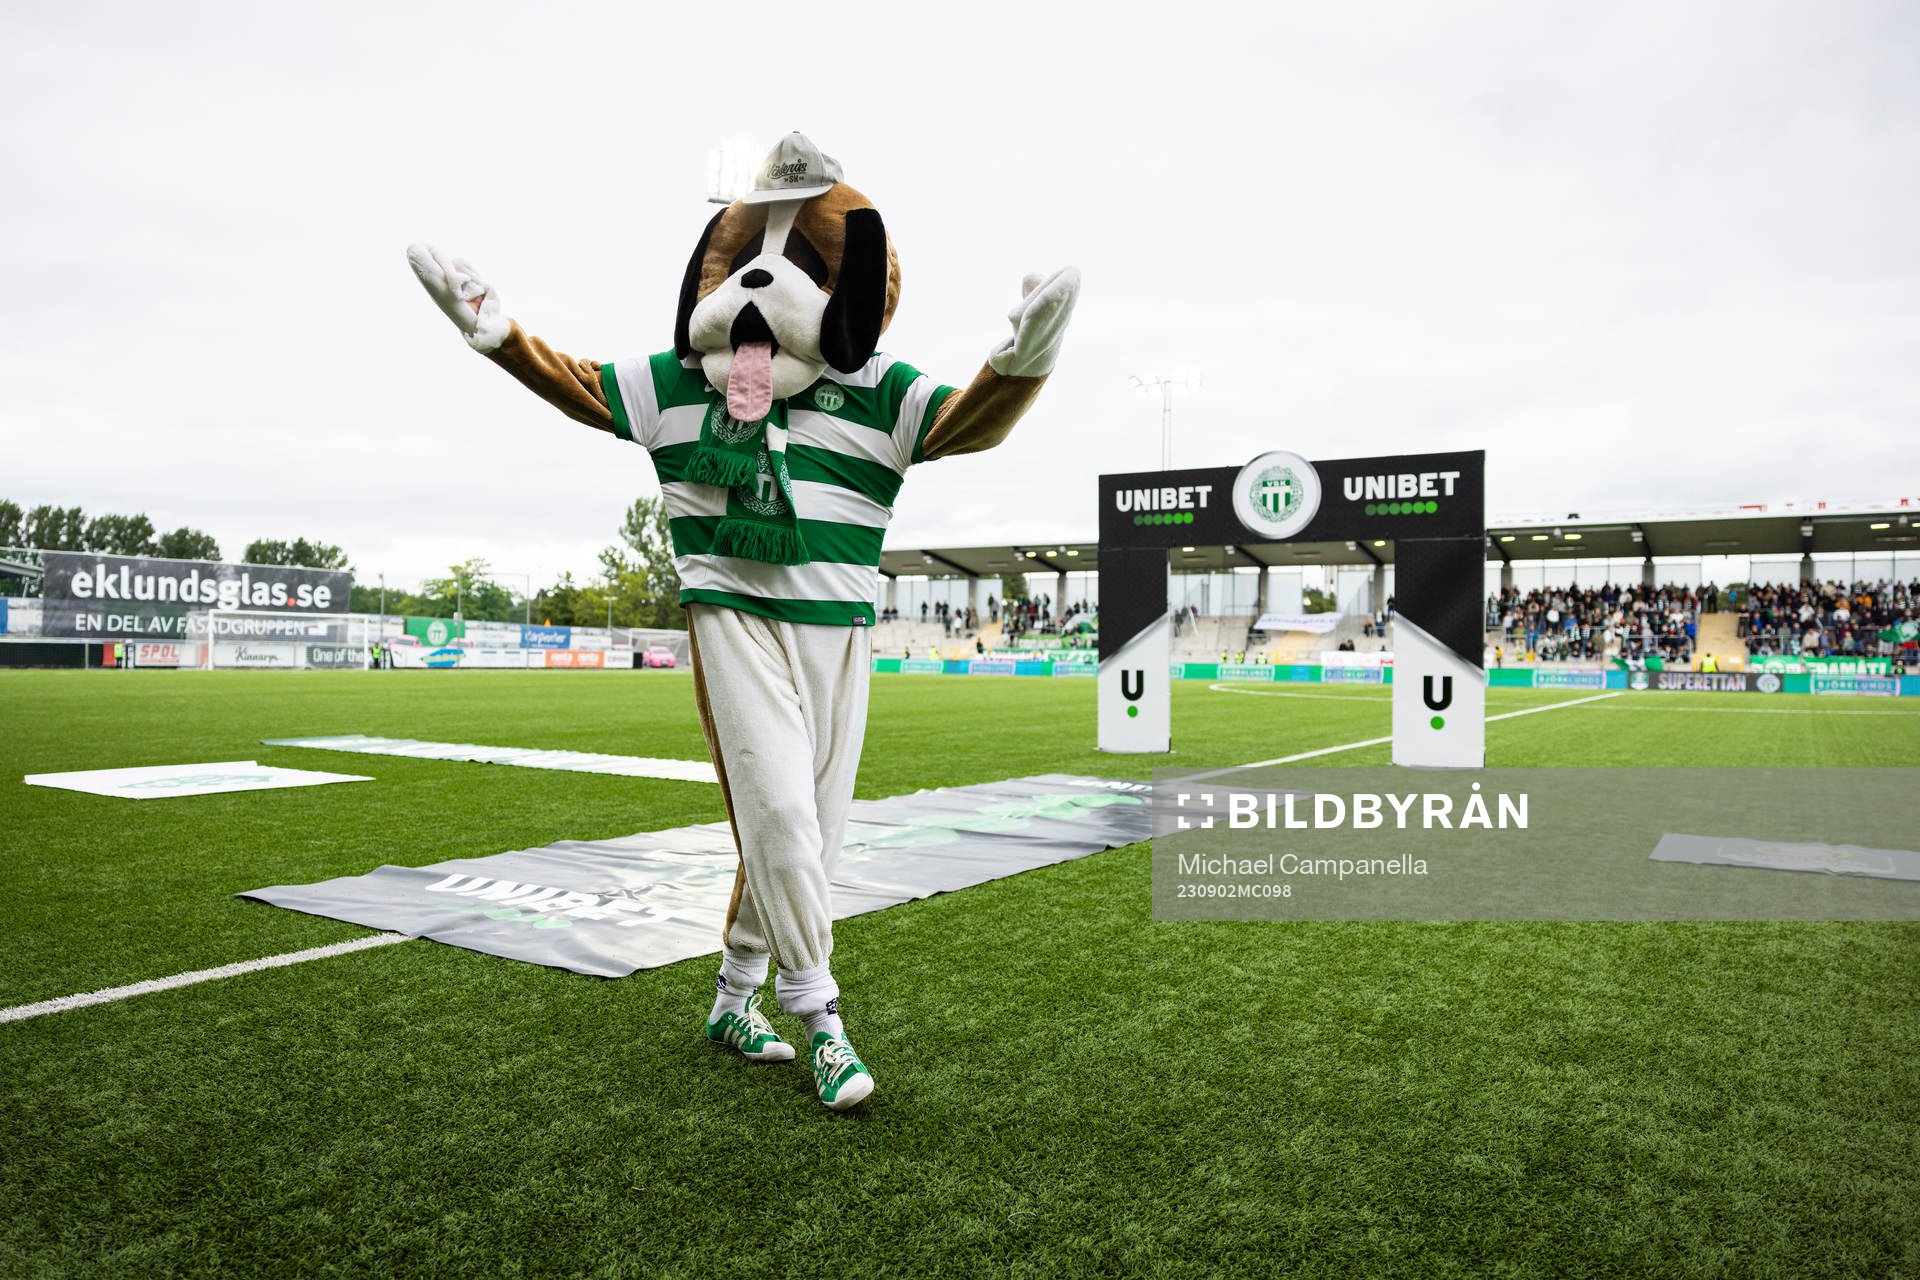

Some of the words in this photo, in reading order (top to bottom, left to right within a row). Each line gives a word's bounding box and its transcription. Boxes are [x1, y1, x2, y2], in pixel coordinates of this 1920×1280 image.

[1116, 485, 1212, 512] UNIBET
[1344, 471, 1460, 501] UNIBET
[71, 563, 331, 610] eklundsglas.se
[75, 613, 102, 631] EN
[107, 614, 144, 632] DEL
[148, 616, 174, 633] AV
[176, 616, 305, 636] FASADGRUPPEN
[1121, 670, 1144, 701] U
[1423, 675, 1453, 711] U
[1658, 672, 1747, 691] SUPERETTAN
